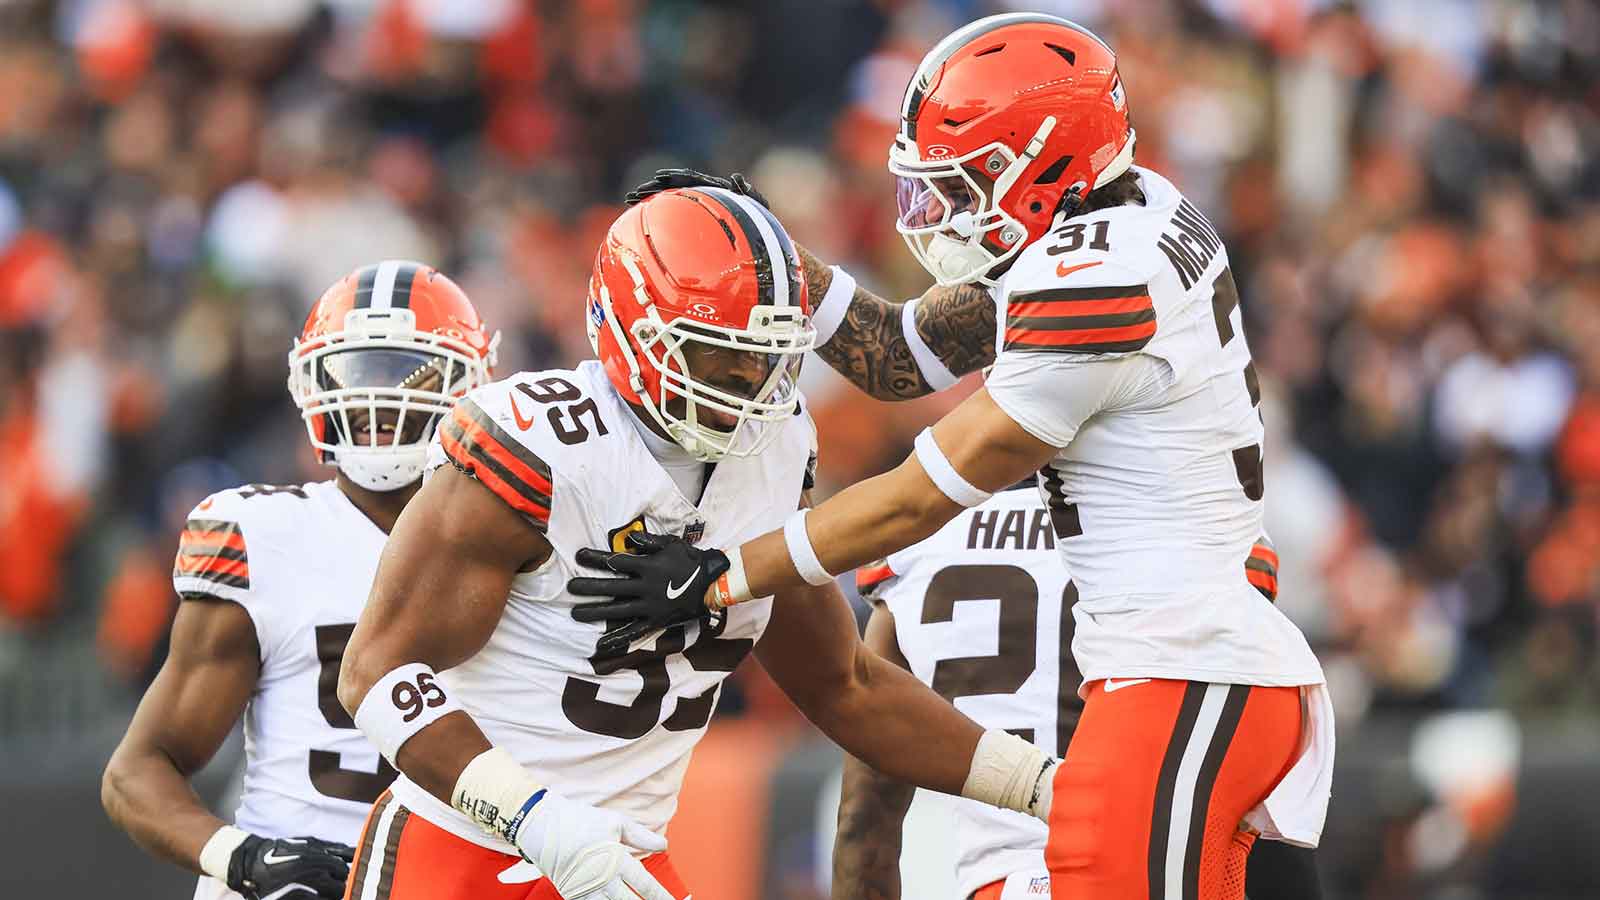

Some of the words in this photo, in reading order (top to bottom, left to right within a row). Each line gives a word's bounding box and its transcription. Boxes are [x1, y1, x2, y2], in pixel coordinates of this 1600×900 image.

[1047, 220, 1110, 256] 31
[515, 377, 609, 445] 95
[391, 672, 447, 722] 95
